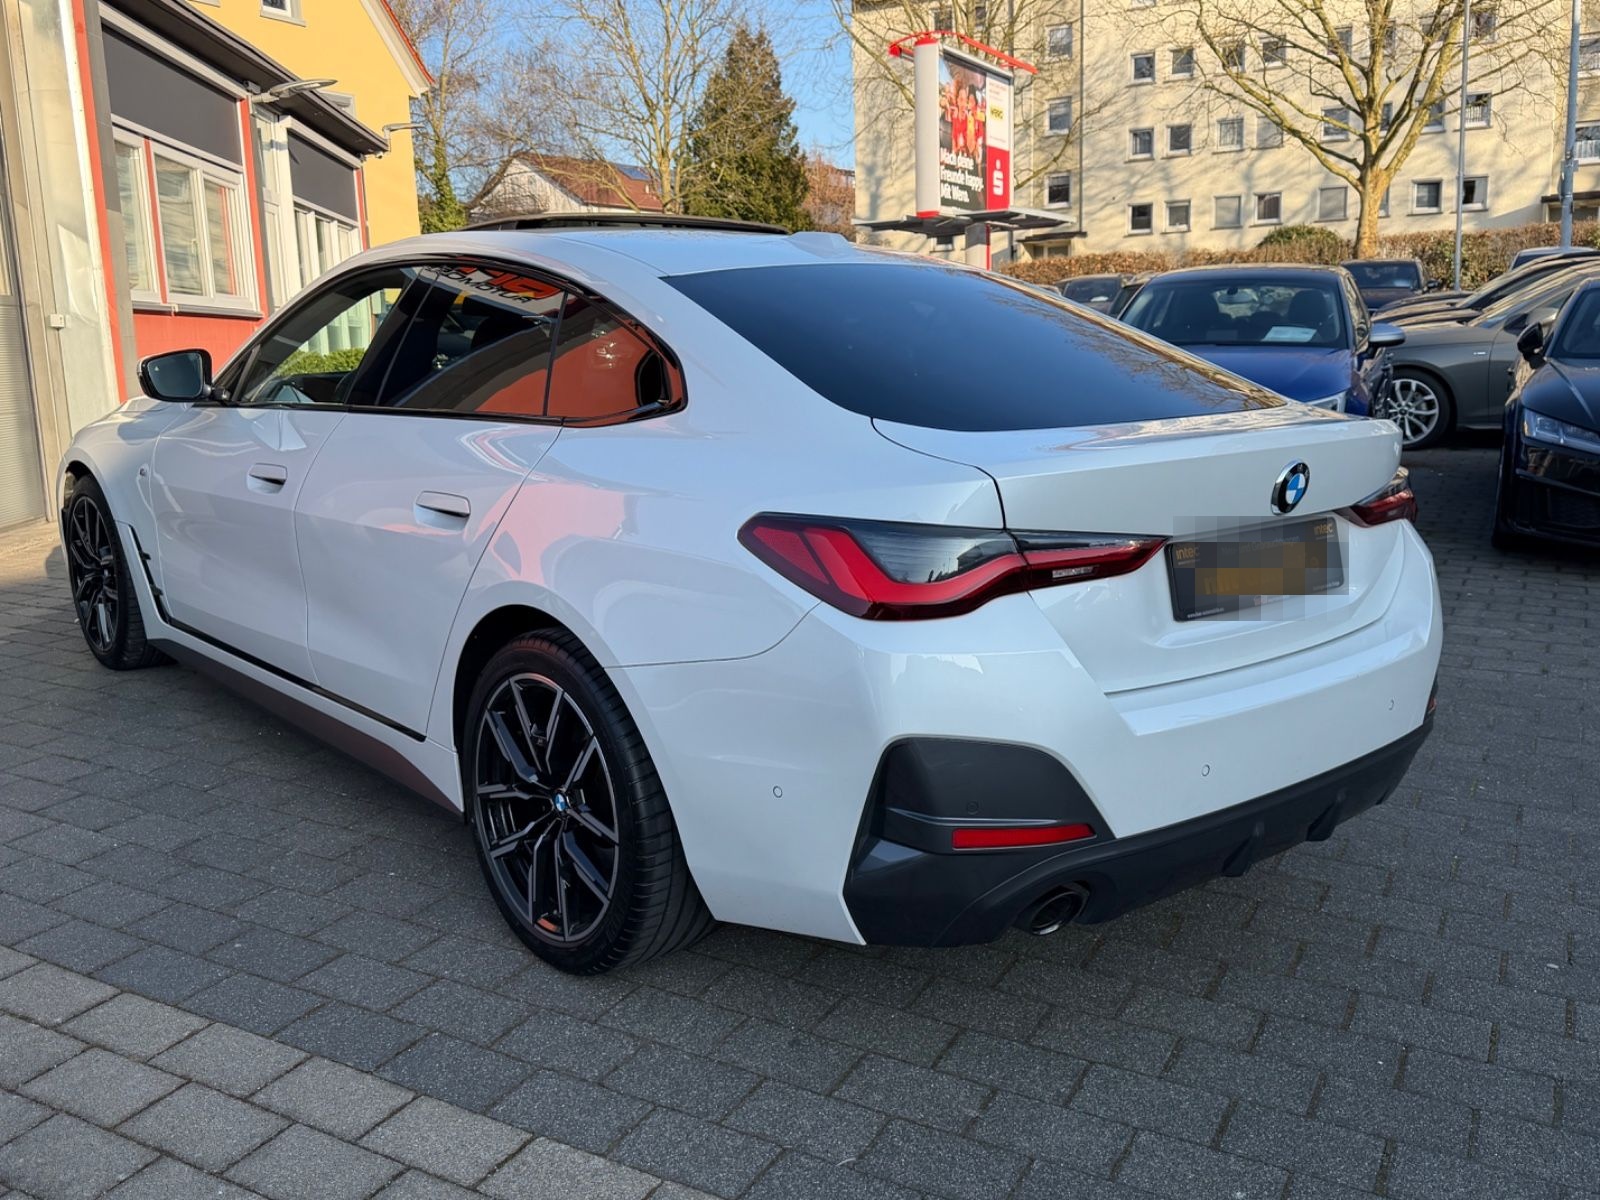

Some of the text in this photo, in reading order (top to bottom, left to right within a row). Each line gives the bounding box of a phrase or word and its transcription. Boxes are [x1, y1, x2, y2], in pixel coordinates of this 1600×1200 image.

[940, 147, 975, 170] Mach deine
[940, 166, 965, 186] Freunde
[940, 183, 952, 199] Mit
